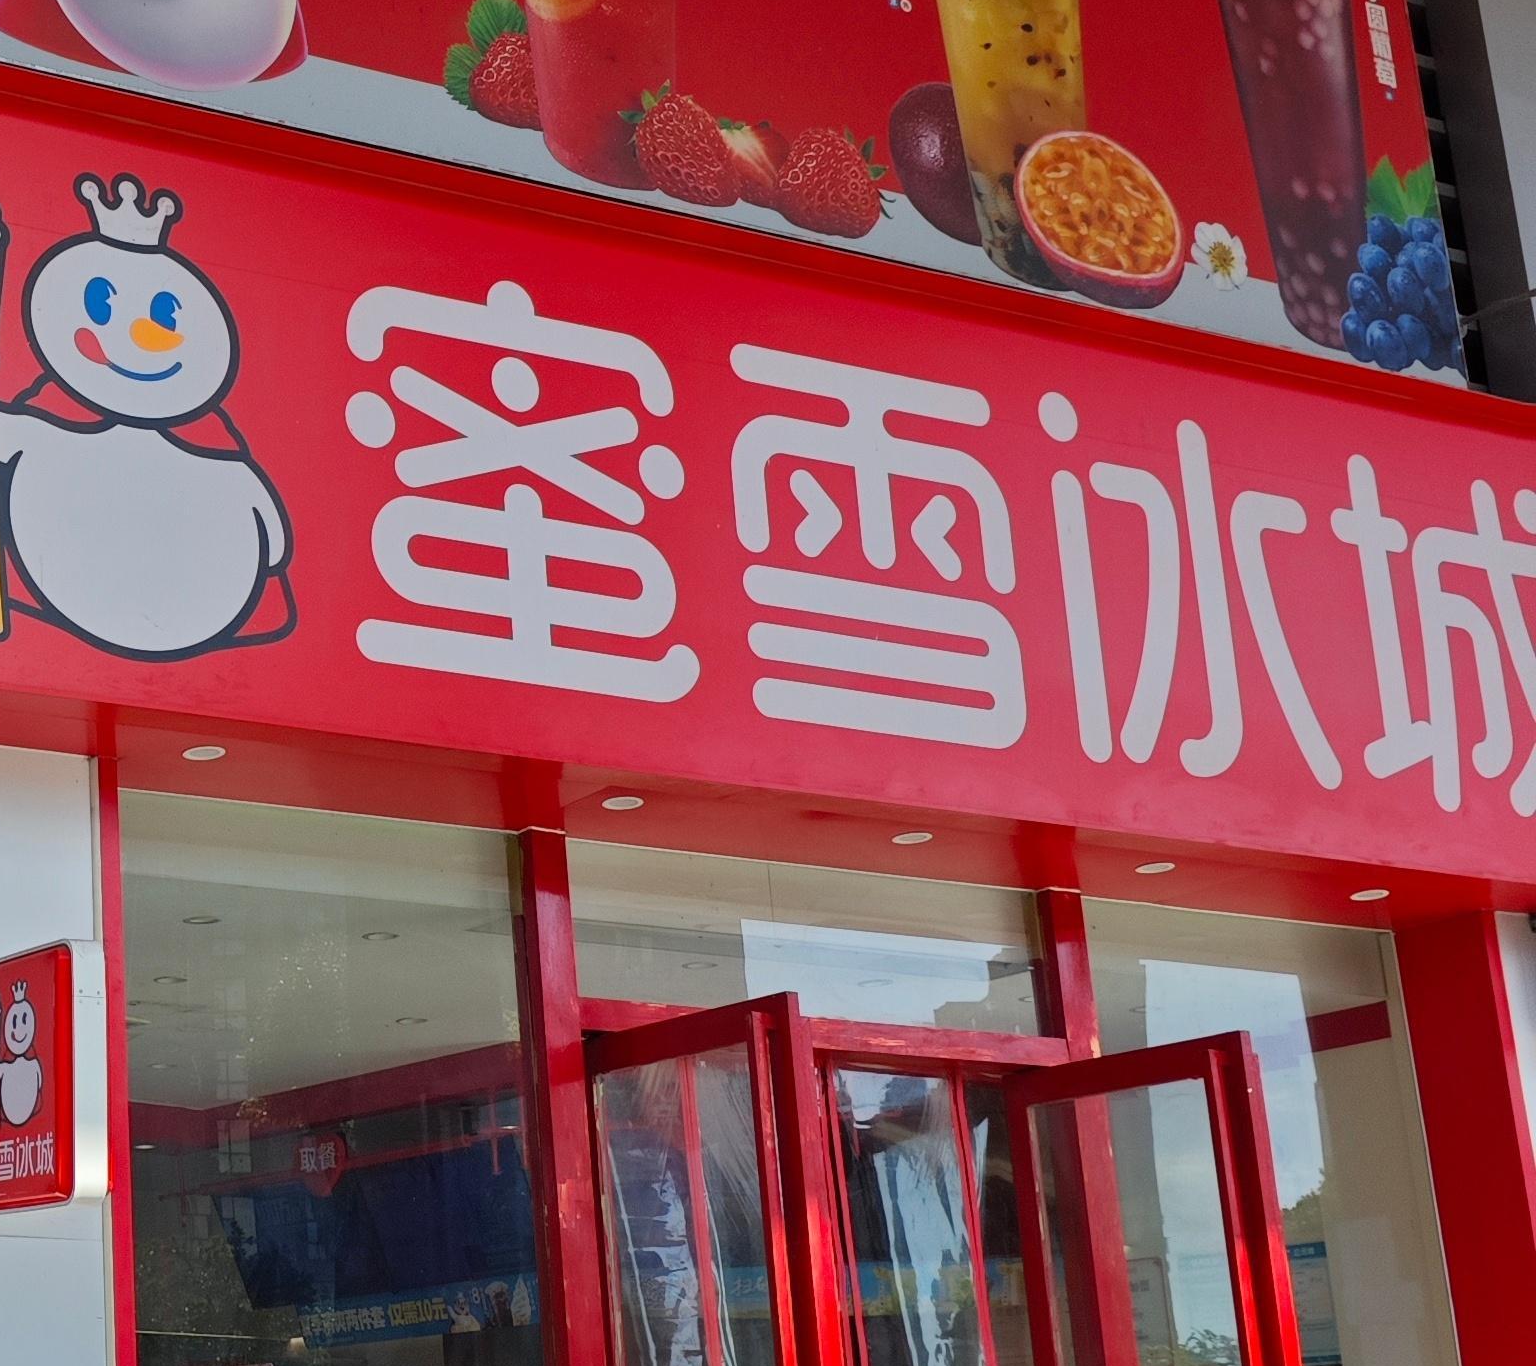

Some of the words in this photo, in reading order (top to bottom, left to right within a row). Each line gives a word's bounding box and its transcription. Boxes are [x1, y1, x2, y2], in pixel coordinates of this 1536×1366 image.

[344, 280, 1536, 819] 蜜雪冰城
[299, 1141, 337, 1173] 取餐
[387, 1295, 449, 1327] 仅需10元
